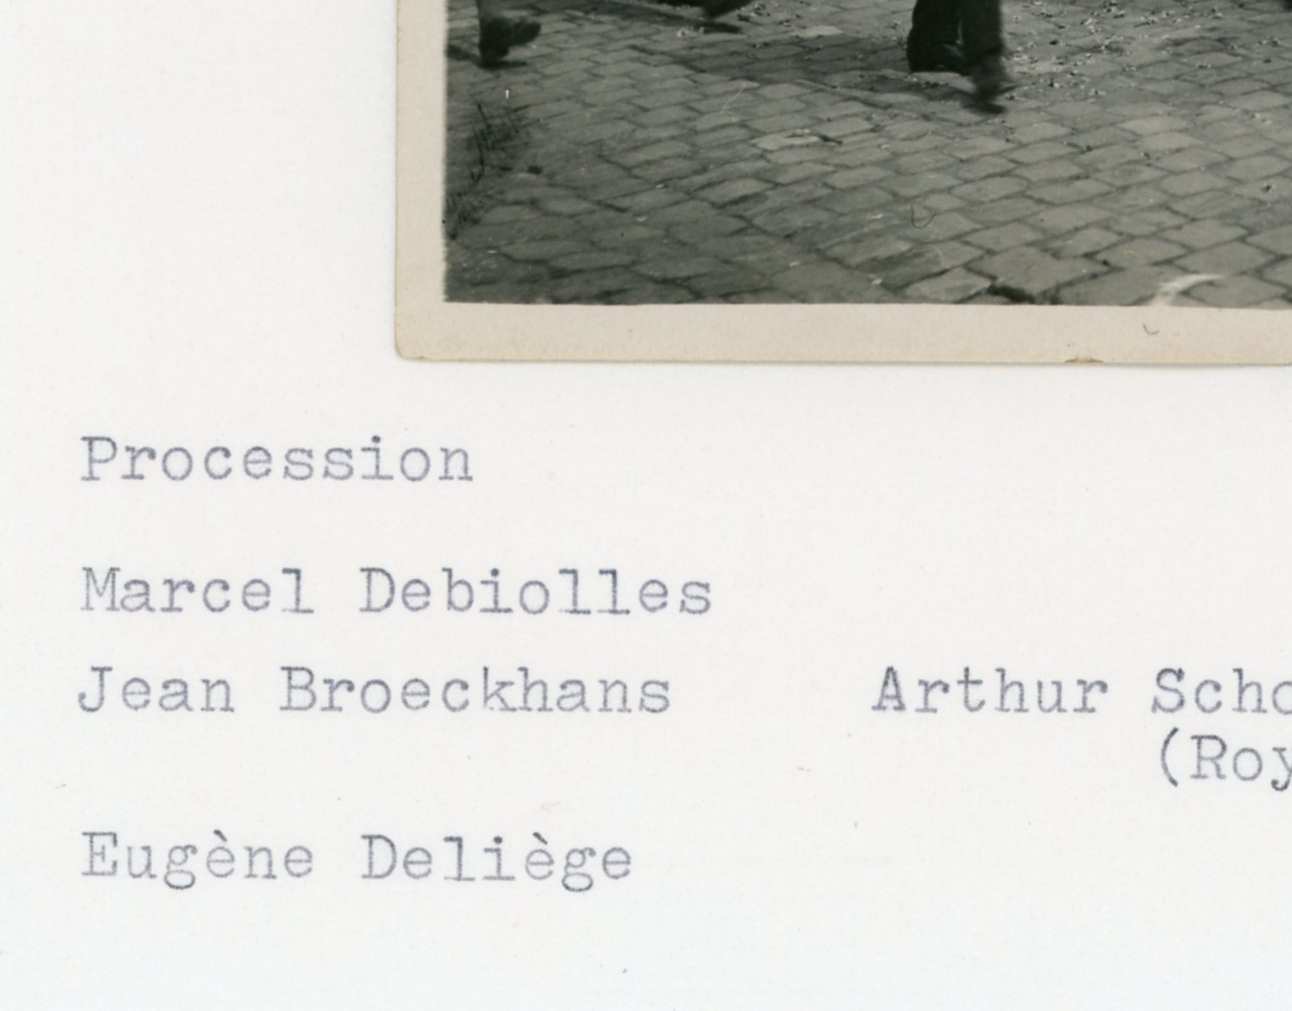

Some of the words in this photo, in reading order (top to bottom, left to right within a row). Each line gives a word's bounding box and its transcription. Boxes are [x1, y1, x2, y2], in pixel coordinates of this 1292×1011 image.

[80, 434, 473, 483] Procession
[82, 566, 314, 614] Marcel
[359, 566, 711, 615] Debiolles
[78, 666, 235, 714] Jean
[279, 665, 670, 714] Broeckhans
[871, 665, 1108, 714] Arthur
[82, 829, 313, 891] Eugène
[361, 831, 631, 893] Deliège
